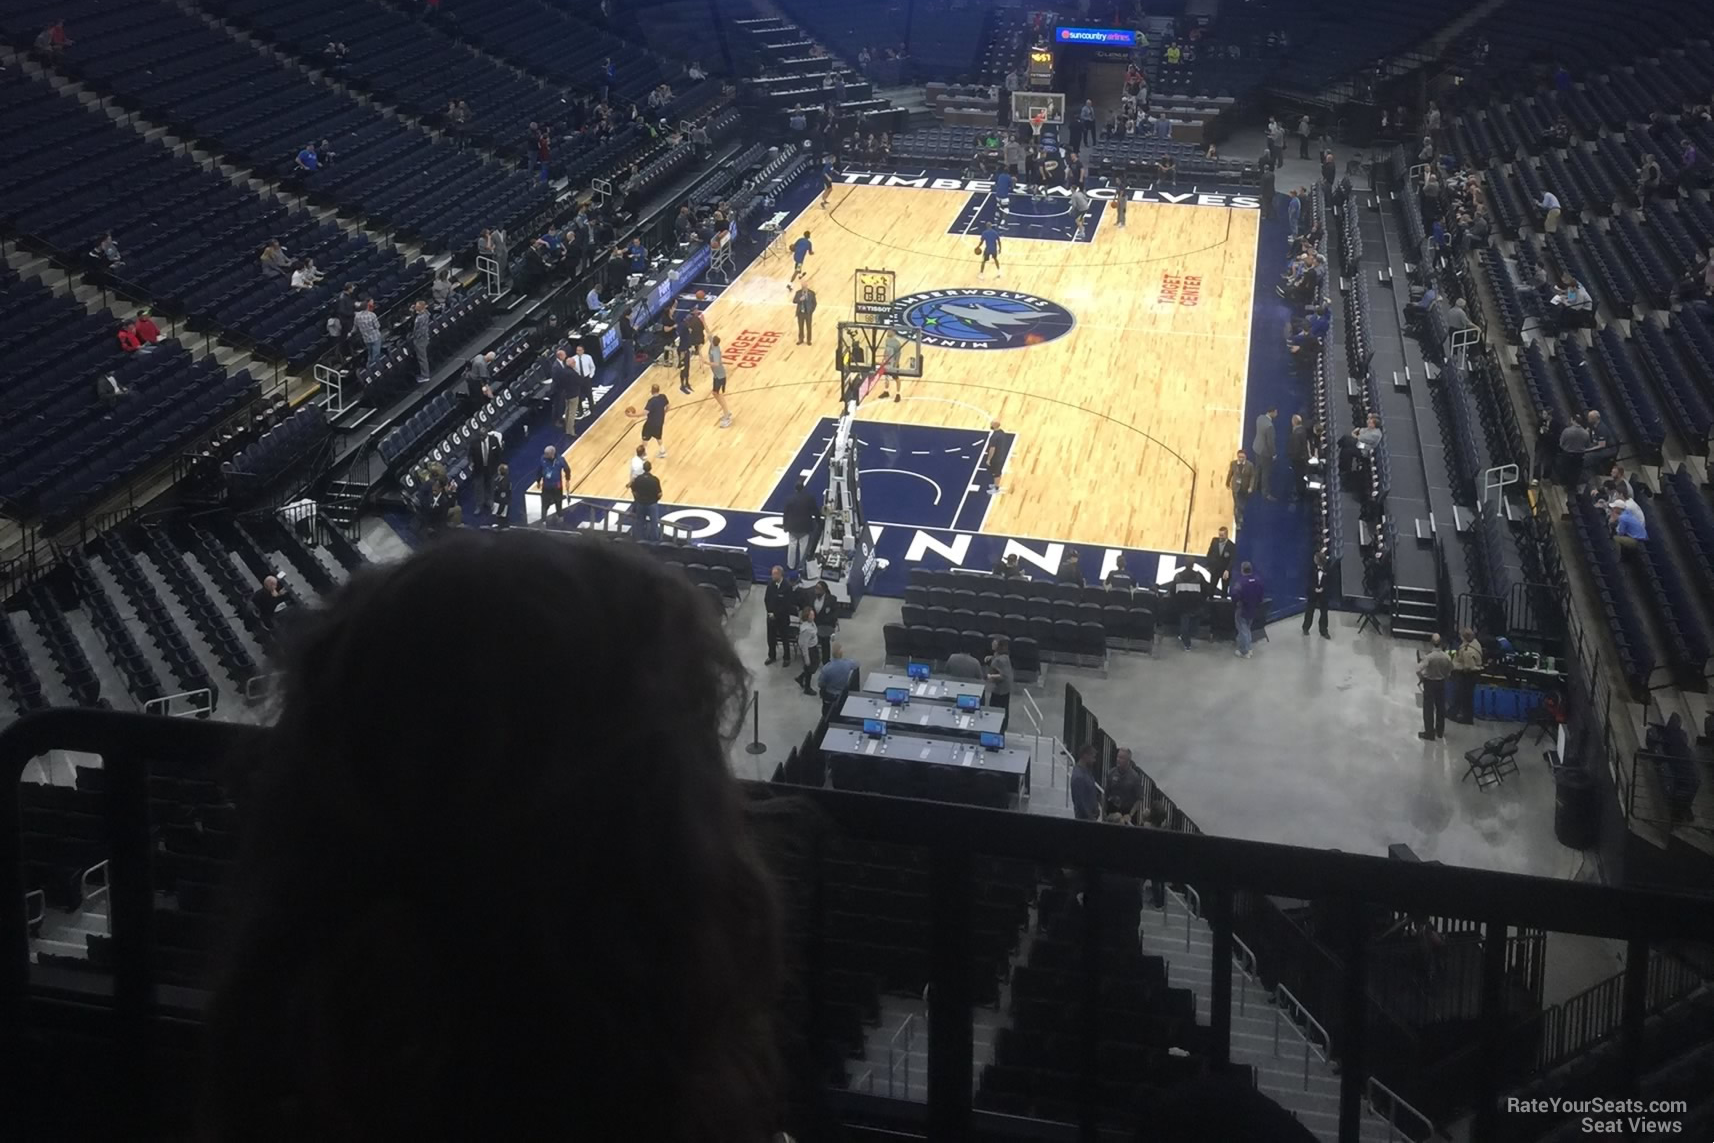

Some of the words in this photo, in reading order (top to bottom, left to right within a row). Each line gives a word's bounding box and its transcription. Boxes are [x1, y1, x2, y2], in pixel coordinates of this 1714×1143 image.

[1157, 274, 1181, 304] TARGET
[1179, 275, 1203, 307] CENTER
[737, 331, 784, 369] CENTER
